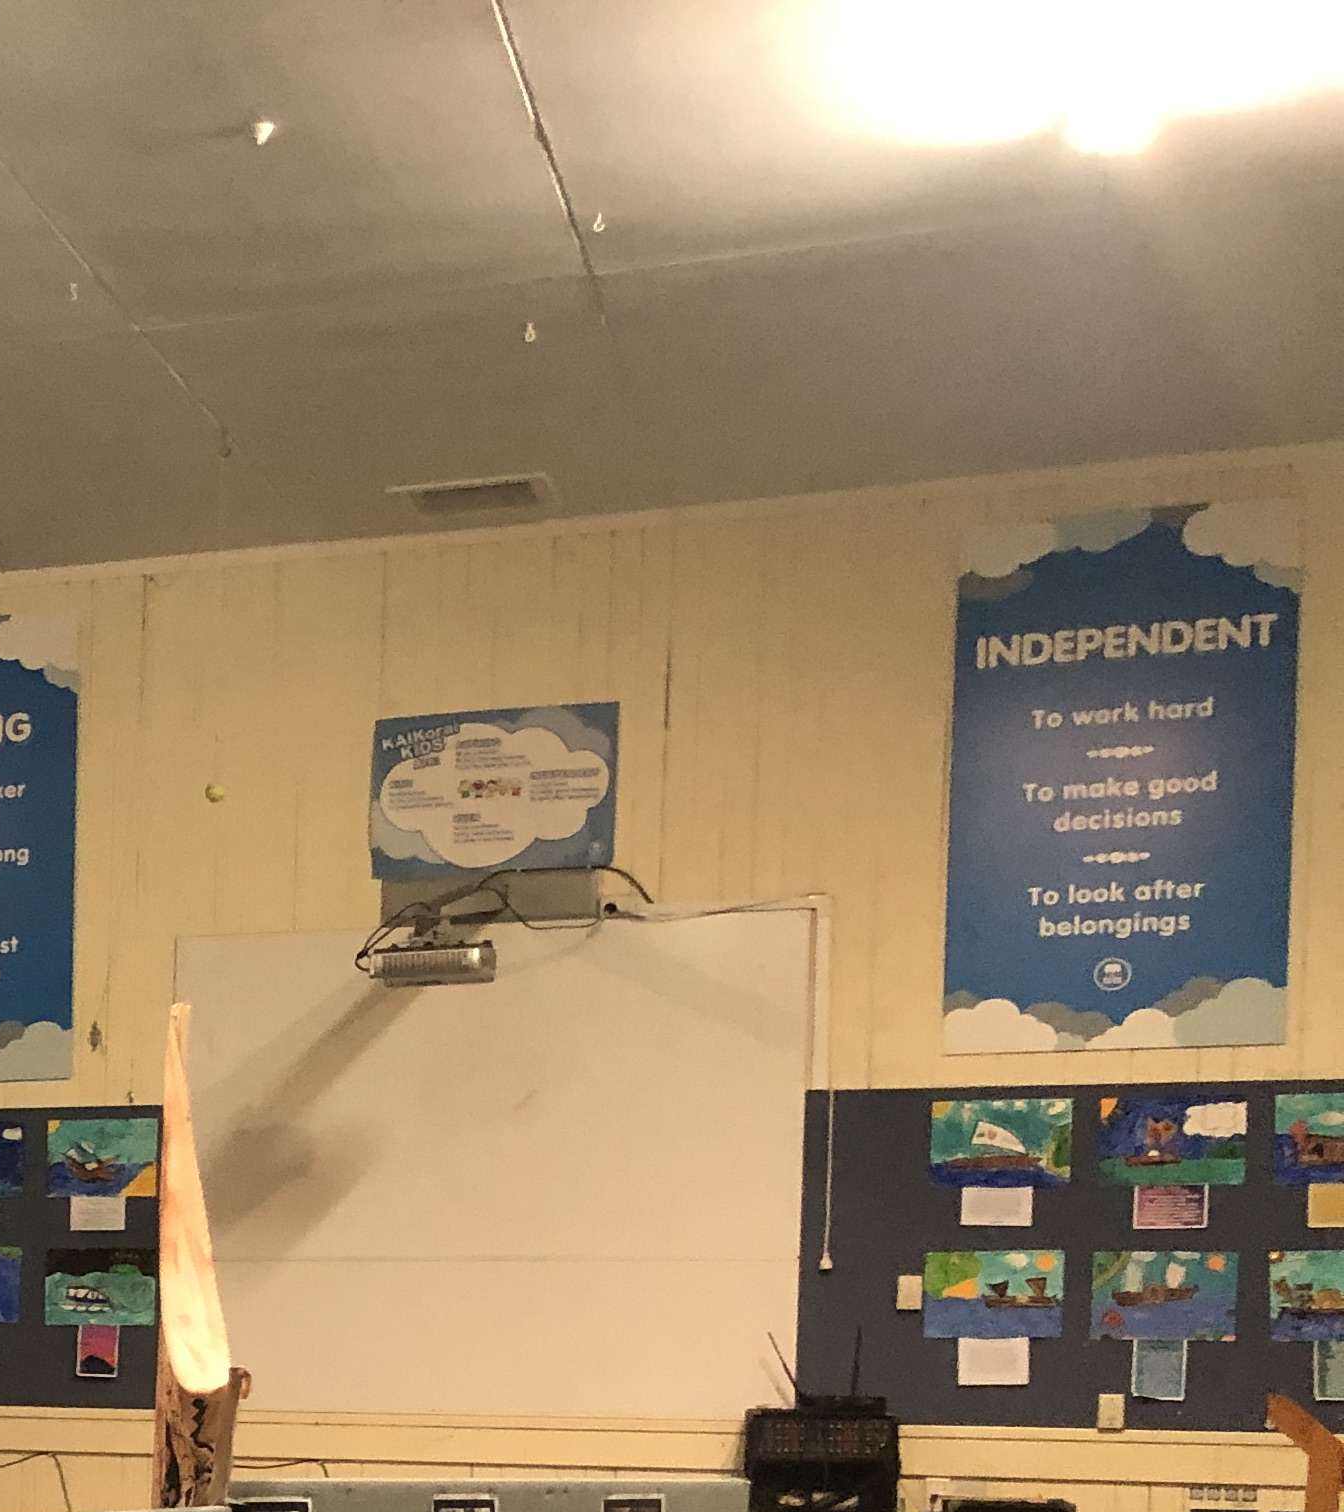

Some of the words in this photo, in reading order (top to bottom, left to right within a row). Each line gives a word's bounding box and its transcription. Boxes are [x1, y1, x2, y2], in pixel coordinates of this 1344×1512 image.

[975, 613, 1278, 669] INDEPENDENT
[1032, 709, 1063, 730] To
[1072, 702, 1139, 726] work
[1148, 697, 1215, 721] hard
[1023, 782, 1054, 802] To
[1063, 777, 1139, 799] make
[1148, 771, 1218, 799] good
[1053, 807, 1183, 833] decisions
[1028, 887, 1059, 907] To
[1068, 881, 1124, 904] look
[1134, 879, 1205, 901] after
[1039, 912, 1191, 938] belongings
